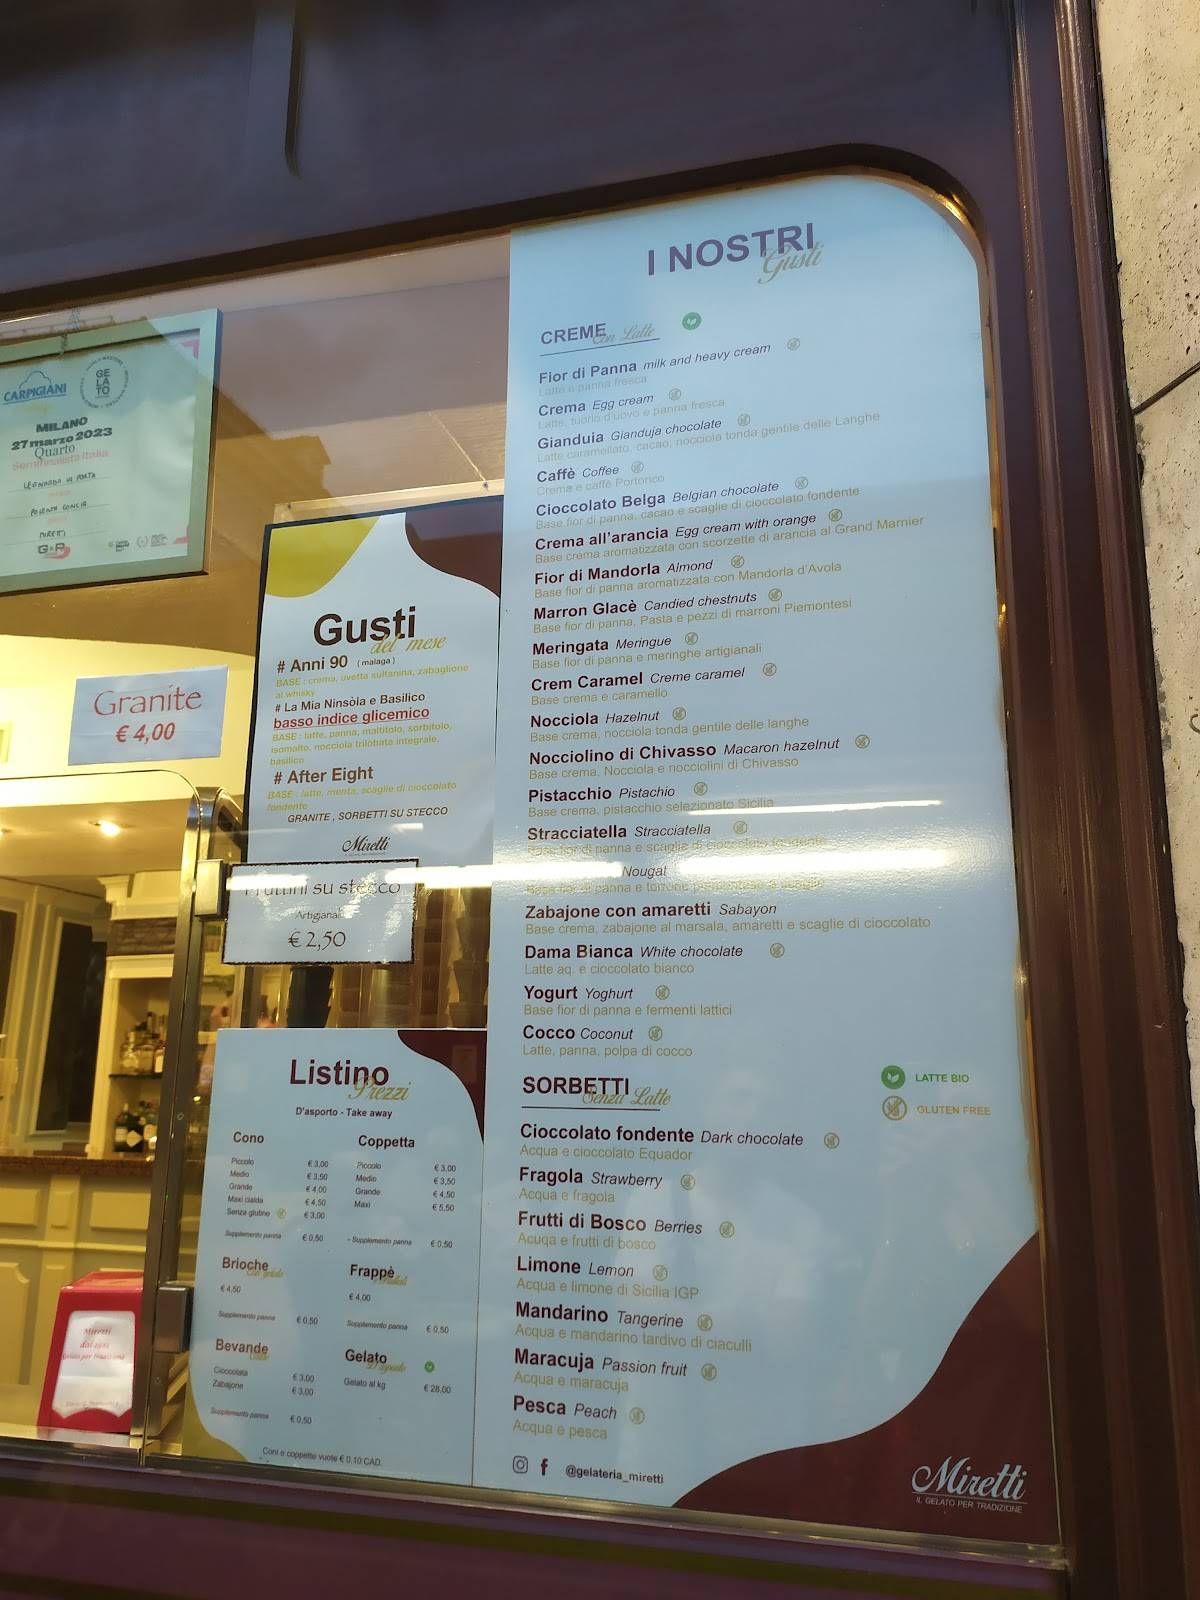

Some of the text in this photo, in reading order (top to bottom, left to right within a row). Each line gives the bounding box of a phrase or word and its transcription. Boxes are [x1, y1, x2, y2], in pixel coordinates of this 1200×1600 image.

[648, 223, 816, 276] I NOSTRI
[757, 241, 823, 284] Gusti
[540, 323, 608, 344] CREME
[95, 368, 111, 378] GE
[539, 344, 770, 383] Fior di Panna milk and heavy cream
[3, 382, 67, 402] CARPIGIANI
[36, 416, 88, 433] MILANO
[537, 420, 721, 449] Gianduia Gianduja chocolate
[11, 427, 113, 451] 27 marzo 2023
[34, 443, 75, 459] Quarto
[536, 465, 619, 482] Caffè Coffee
[536, 483, 778, 516] Cioccolato Belga Belgian chocolate
[535, 515, 816, 550] Crema all'arancia Egg cream with orange
[313, 607, 417, 646] Gusti
[369, 633, 447, 655] del mese
[277, 654, 348, 673] # Anni 90
[531, 667, 745, 690] Crem Caramel Creme caramel
[94, 684, 203, 717] Granite
[275, 692, 425, 712] # La Mia Ninsòla e Basilico
[273, 708, 429, 728] basso indice glicemico
[530, 711, 659, 727] Nocciola Hazelnut
[115, 722, 176, 745] € 4,00
[529, 738, 839, 764] Nocciolino di Chivasso Macaron hazelnut
[274, 766, 373, 784] # After Eight
[528, 786, 674, 802] Pistacchio Pistachio
[287, 812, 331, 822] GRANITE
[338, 809, 387, 820] SORBETTI
[389, 808, 404, 817] SU
[406, 806, 448, 816] STECCO
[527, 824, 710, 840] Stracciatella Stracciatella
[622, 863, 667, 880] Nougat
[312, 883, 334, 895] su
[525, 902, 776, 921] Zabajone con amaretti Sabayon
[287, 928, 346, 951] € 2,50
[524, 985, 632, 1002] Yogurt Yoghurt
[523, 1002, 732, 1018] Base fior di panna e fermenti lattici
[522, 1024, 633, 1039] Cocco Coconut
[289, 1059, 390, 1086] Listino
[915, 1073, 969, 1082] LATTE BIO
[347, 1078, 412, 1102] Prezzi
[522, 1076, 628, 1095] SORBETTI
[630, 1086, 672, 1108] Latte
[295, 1106, 338, 1116] D'asporto
[345, 1107, 367, 1116] Take
[369, 1110, 392, 1119] away
[916, 1105, 990, 1115] GLUTEN FREE
[233, 1131, 264, 1143] Cono
[358, 1134, 414, 1149] Coppetta
[520, 1123, 803, 1145] Cioccolato fondente Dark chocolate
[519, 1166, 662, 1188] Fragola Strawberry
[518, 1210, 702, 1234] Frutti di Bosco Berries
[222, 1256, 268, 1272] Brioche
[350, 1264, 396, 1280] Frappè
[517, 1256, 633, 1276] Limone Lemon
[516, 1278, 699, 1299] Acqua e limone di Sicilia IGP
[516, 1301, 683, 1328] Mandarino Tangerine
[215, 1338, 268, 1356] Bevande
[345, 1349, 387, 1364] Gelato
[514, 1348, 686, 1376] Maracuja Passion fruit
[423, 1383, 451, 1394] € 28,00
[513, 1395, 616, 1418] Pesca Peach
[565, 1466, 664, 1483] @gelateria_miretti
[911, 1454, 1030, 1501] Miretti
[924, 1497, 955, 1508] GELATO
[957, 1500, 974, 1509] PER
[976, 1502, 1023, 1513] TRADIZIONE
